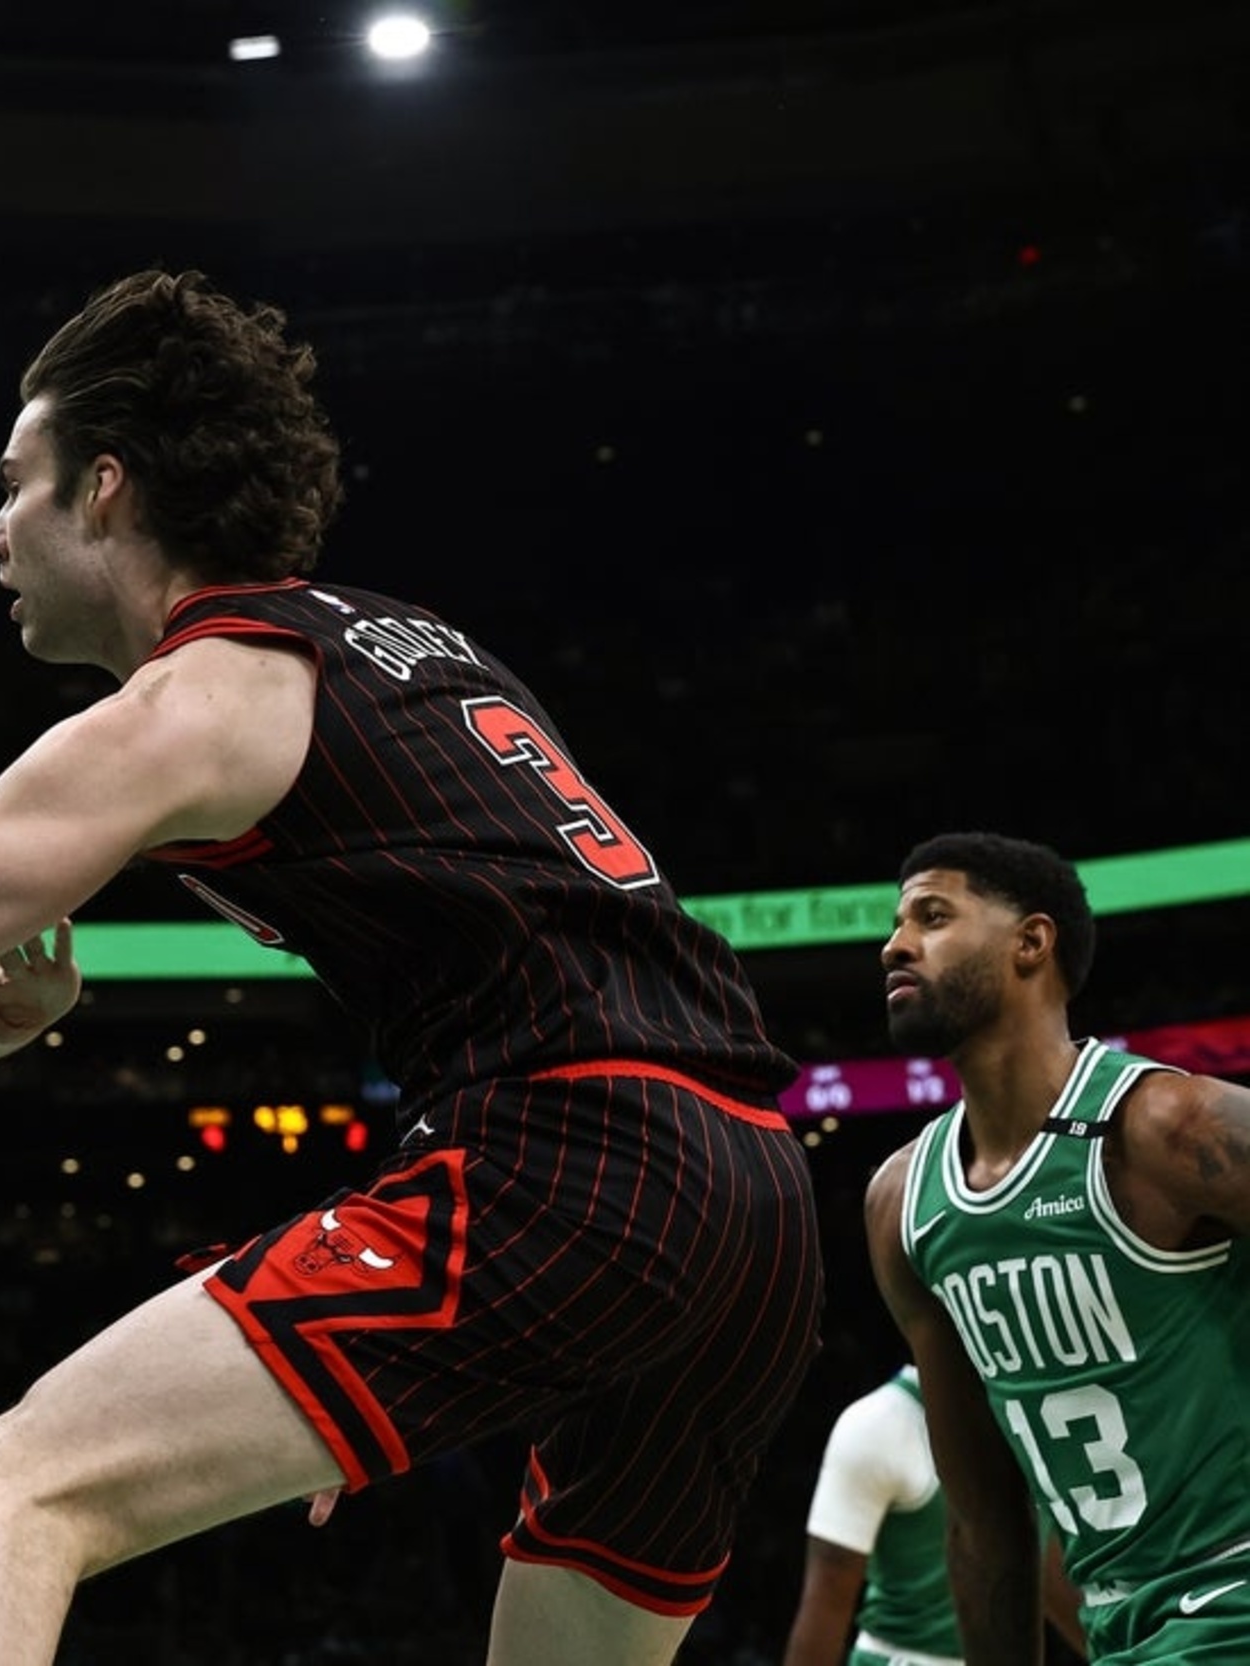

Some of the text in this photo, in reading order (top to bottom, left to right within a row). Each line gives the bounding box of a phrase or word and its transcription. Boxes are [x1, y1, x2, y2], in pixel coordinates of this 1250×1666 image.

[461, 696, 660, 890] 3
[1024, 1194, 1085, 1220] Amica
[931, 1253, 1137, 1380] OSTON
[1005, 1383, 1148, 1536] 13
